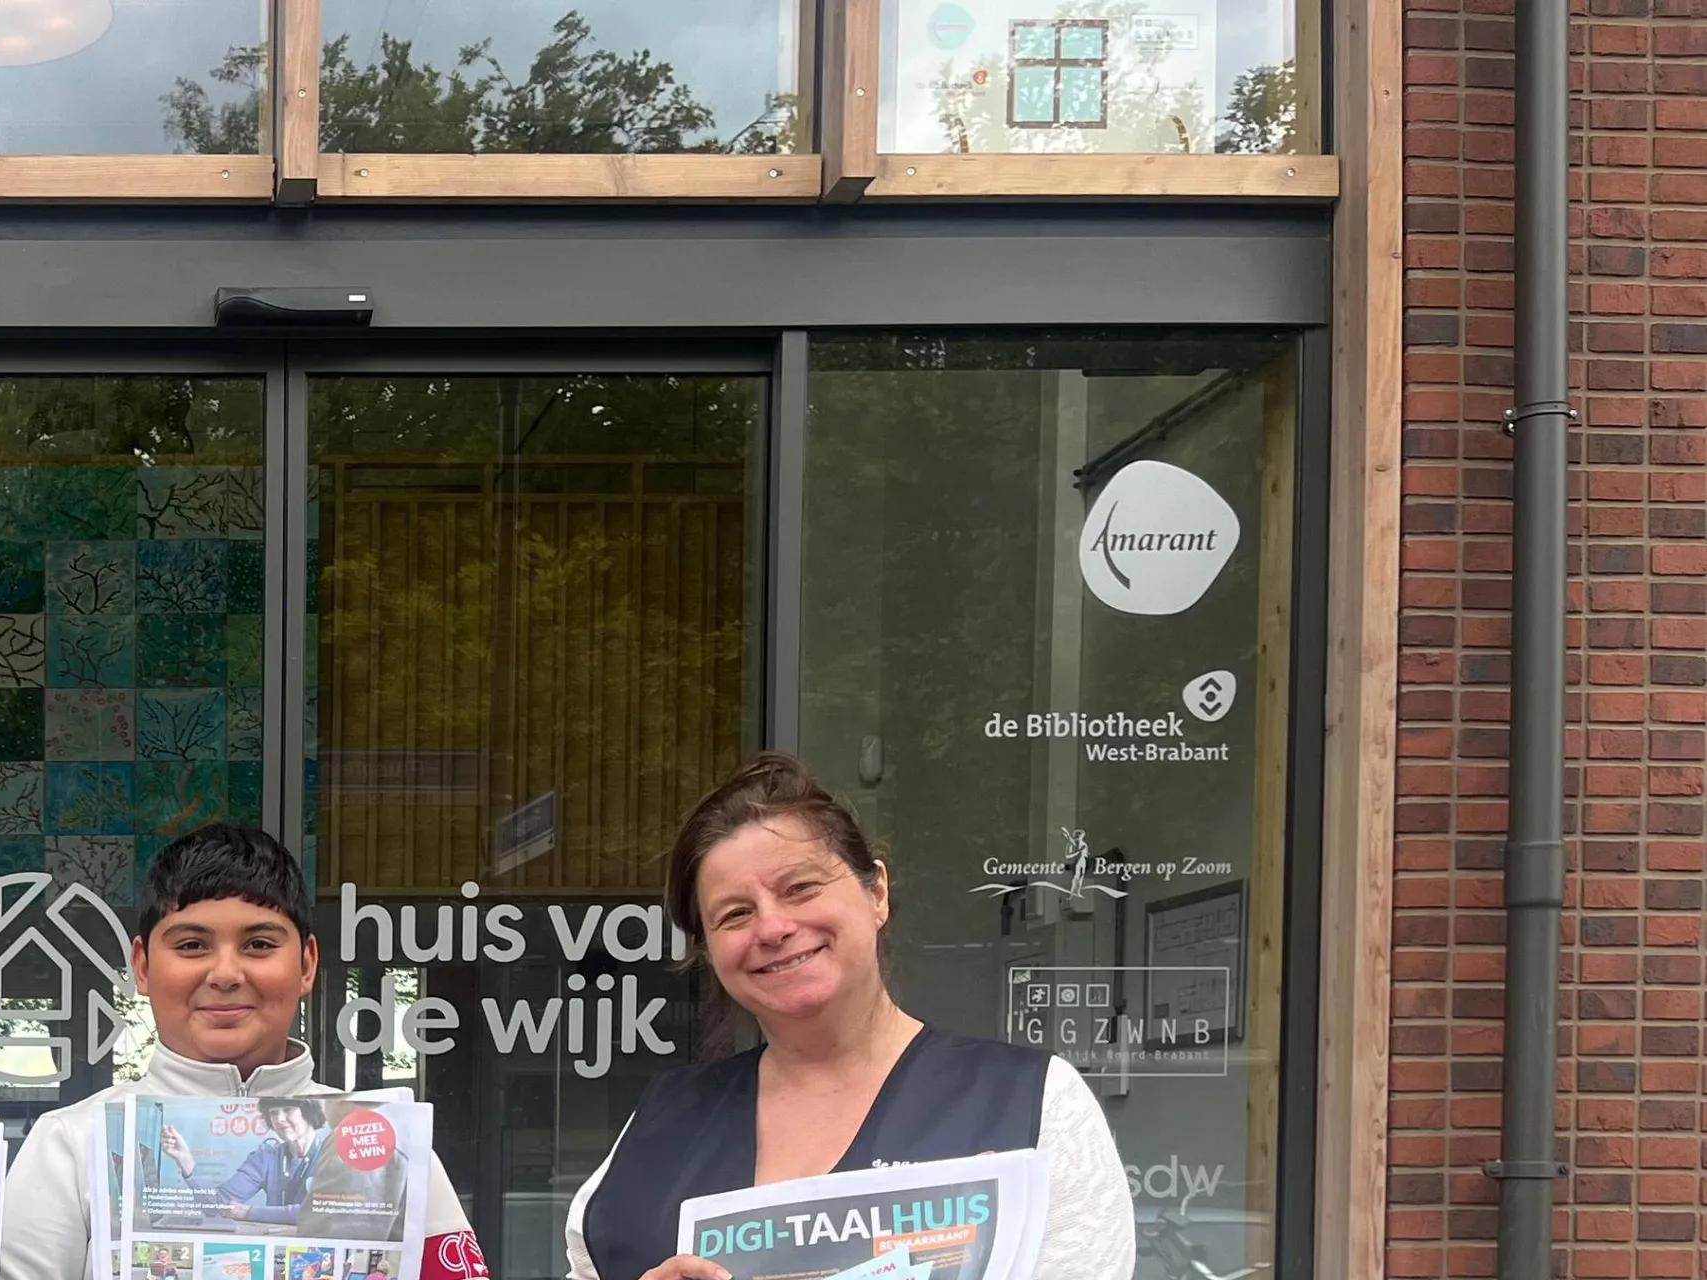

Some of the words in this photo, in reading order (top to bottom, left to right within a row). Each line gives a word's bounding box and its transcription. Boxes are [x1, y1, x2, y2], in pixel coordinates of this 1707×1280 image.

[1090, 500, 1218, 589] Amarant
[985, 713, 1018, 738] de
[1026, 712, 1184, 738] Bibliotheek
[1086, 743, 1230, 762] West-Brabant
[983, 857, 1065, 876] Gemeente
[1094, 857, 1152, 881] Bergen
[1156, 863, 1176, 881] op
[1181, 857, 1232, 875] Zoom
[340, 881, 526, 963] huis
[336, 974, 460, 1055] de
[481, 974, 676, 1079] wijk
[341, 1122, 386, 1137] PUZZEL
[352, 1134, 378, 1147] MEE
[348, 1149, 358, 1159] &
[359, 1145, 386, 1158] WIN
[1124, 1155, 1225, 1199] sdw
[699, 1193, 990, 1258] DIGI-TAALHUIS
[180, 1247, 190, 1260] 2
[251, 1249, 261, 1261] 2
[322, 1253, 331, 1264] 3
